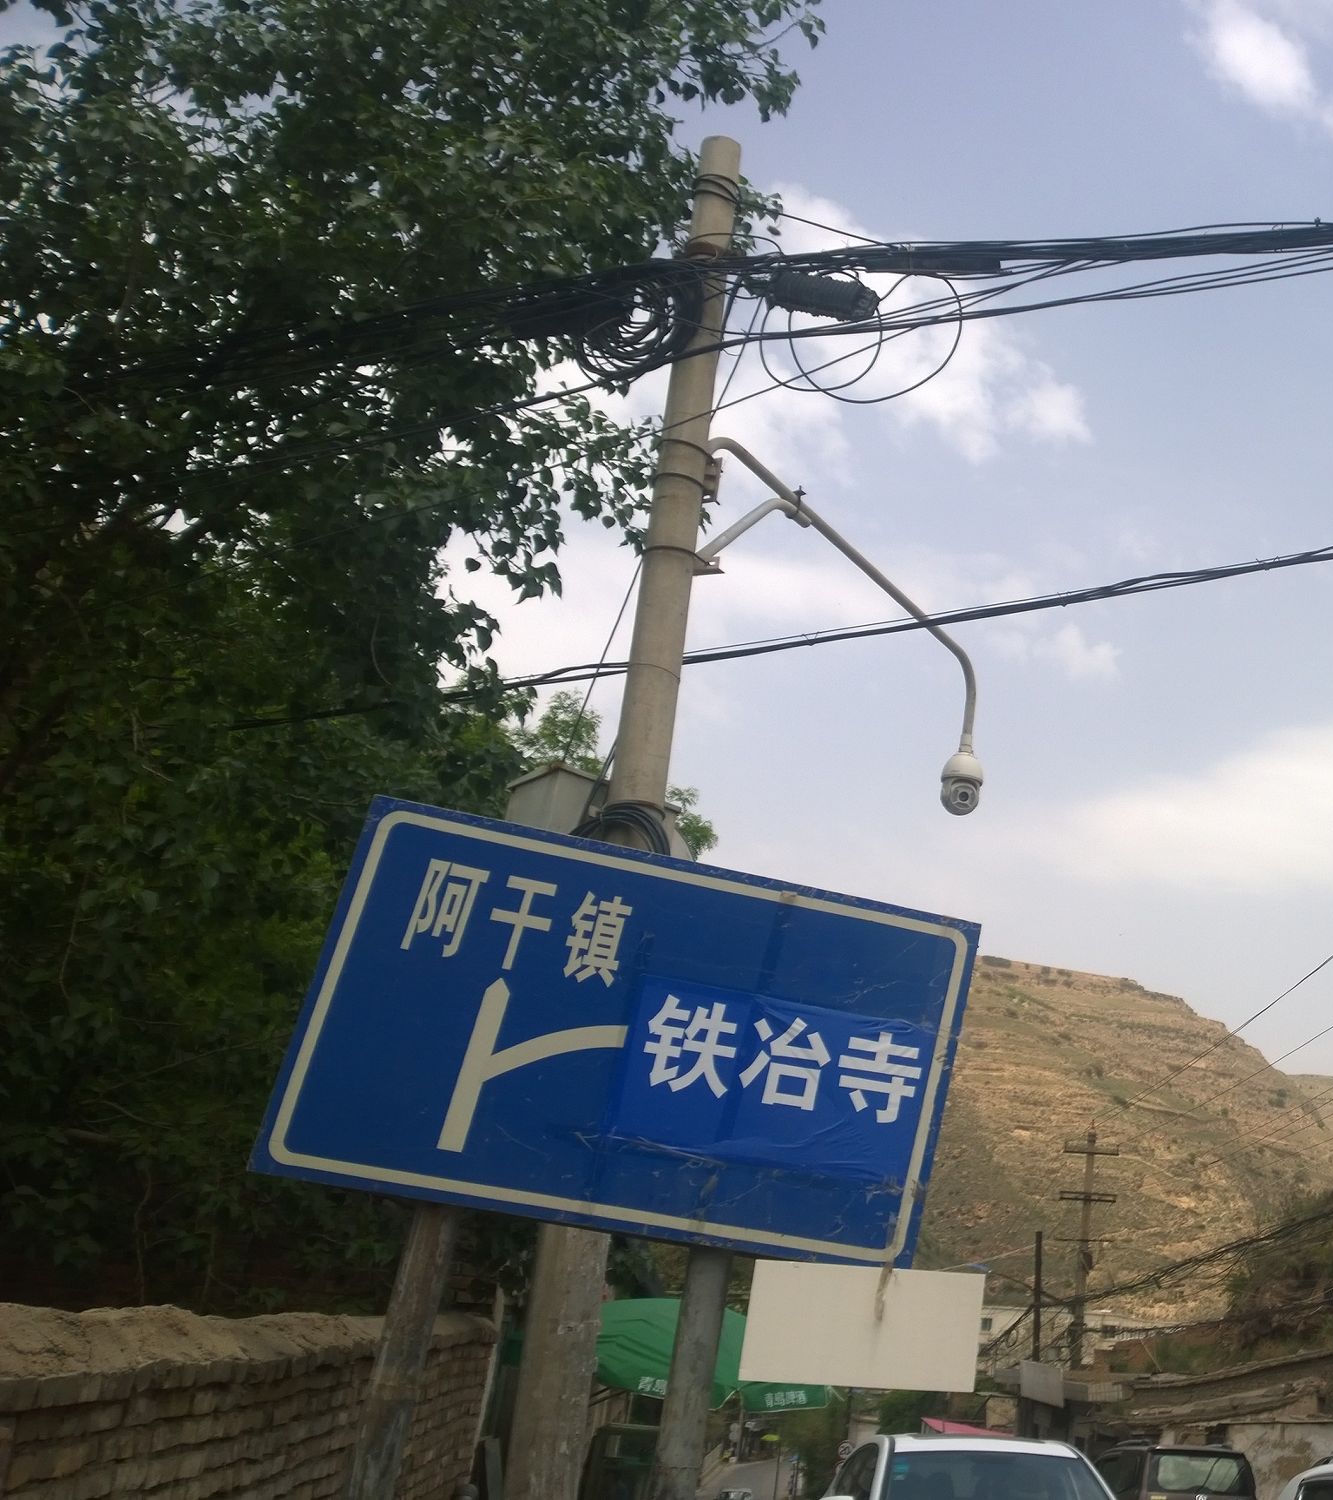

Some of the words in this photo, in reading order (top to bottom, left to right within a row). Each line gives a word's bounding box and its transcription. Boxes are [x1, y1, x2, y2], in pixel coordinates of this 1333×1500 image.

[400, 858, 632, 987] 阿干镇
[642, 994, 922, 1124] 铁冶寺
